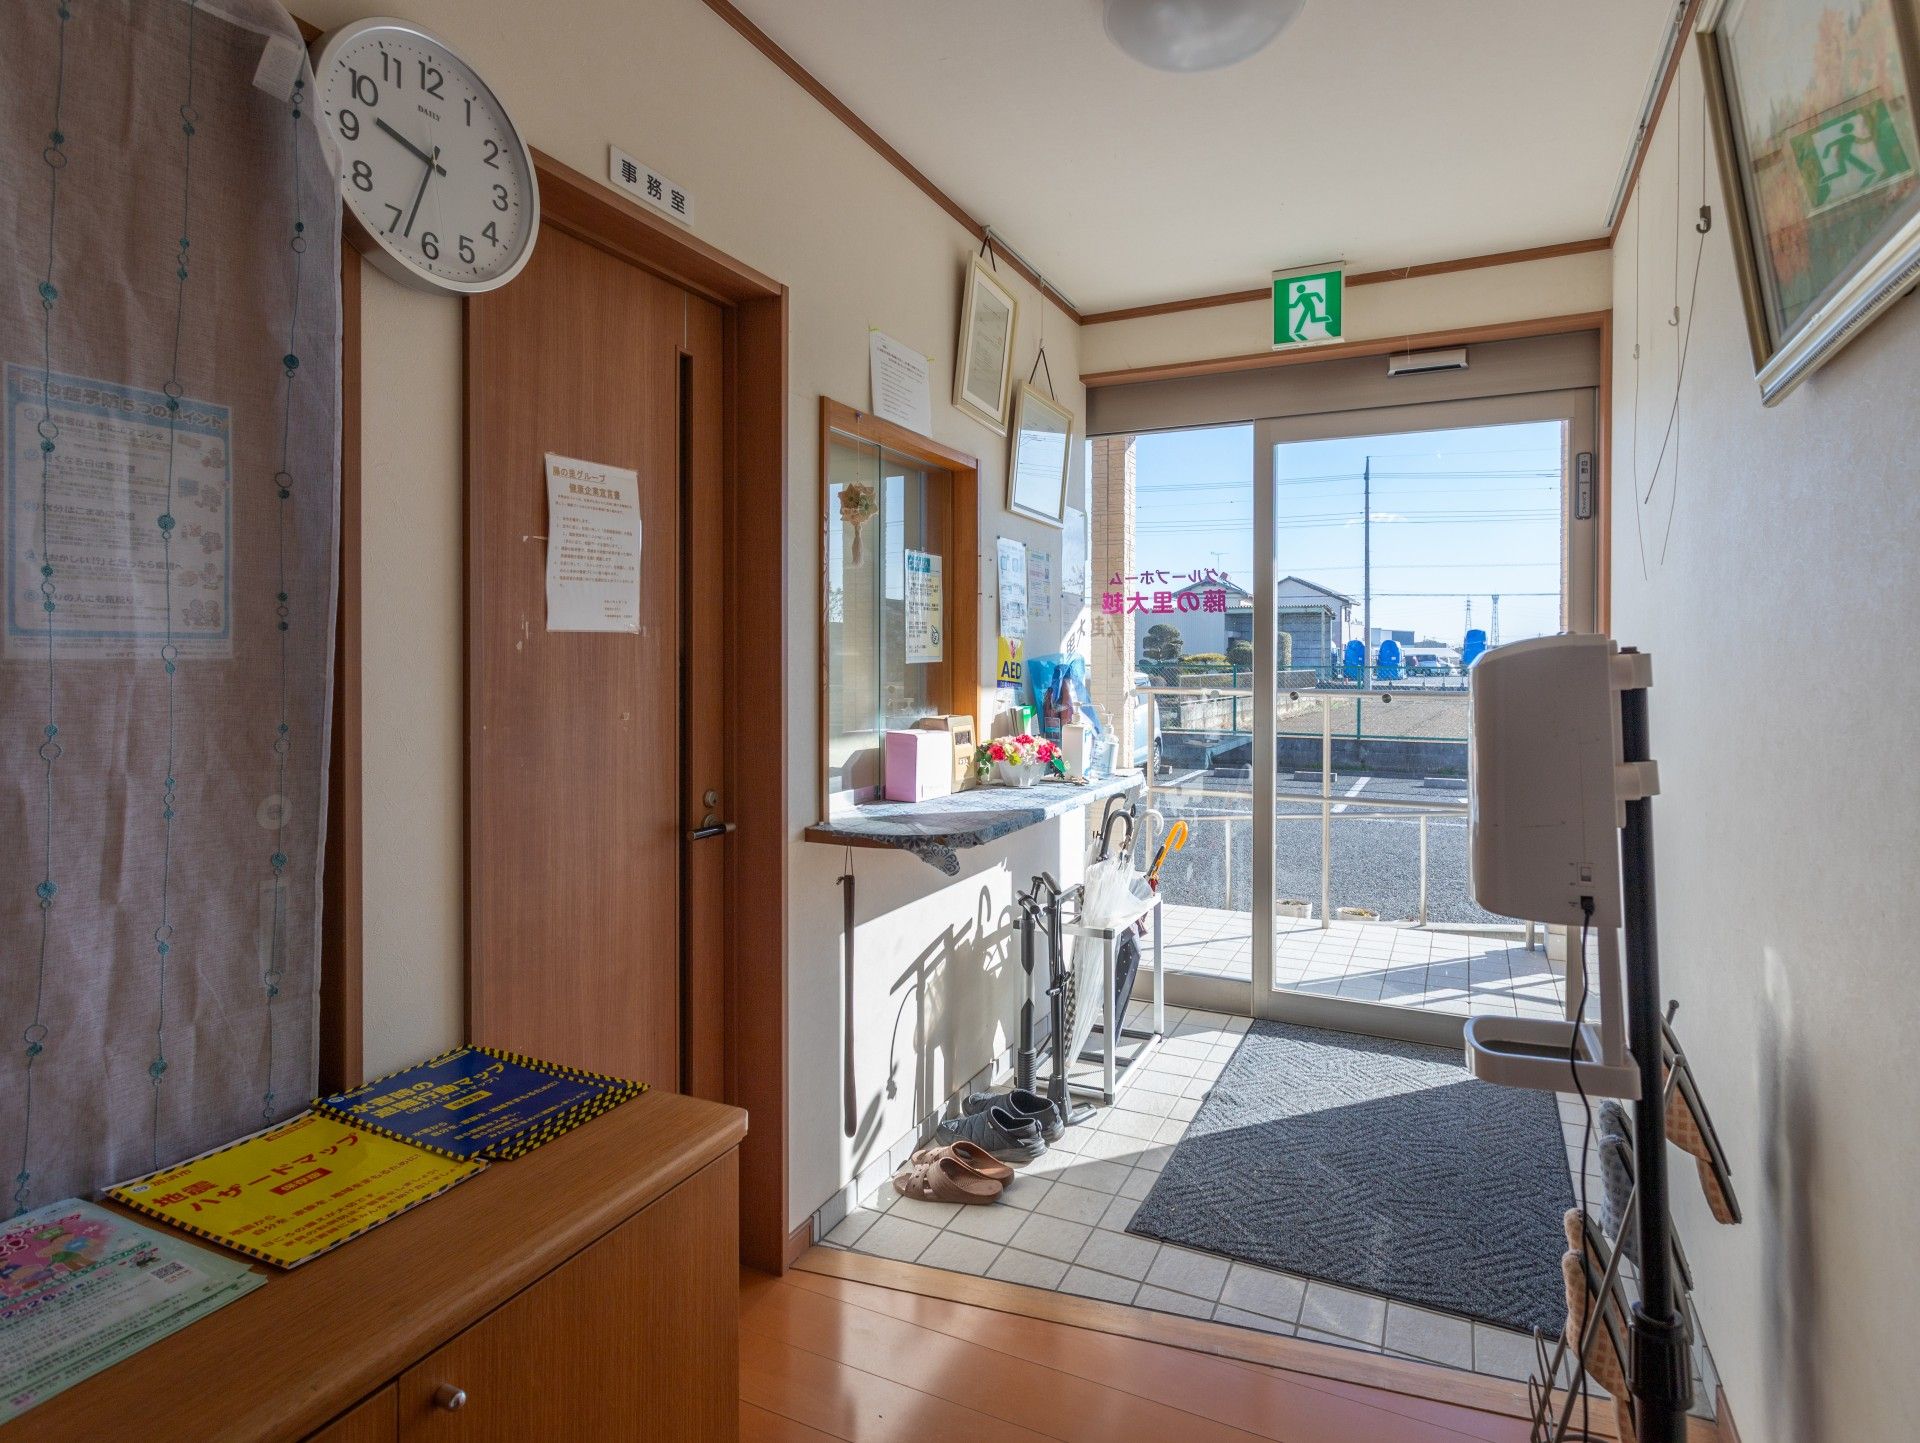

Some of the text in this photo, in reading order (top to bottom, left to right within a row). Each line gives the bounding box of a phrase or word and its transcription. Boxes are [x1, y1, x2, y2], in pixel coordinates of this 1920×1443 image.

[381, 52, 401, 89] 11
[418, 60, 444, 100] 12
[350, 67, 378, 108] 10
[339, 109, 360, 141] 9
[463, 98, 472, 126] 1
[483, 139, 499, 169] 2
[352, 160, 373, 193] 8
[621, 158, 685, 215] 事務室
[492, 184, 508, 212] 3
[385, 203, 403, 234] 7
[421, 232, 439, 260] 6
[482, 221, 499, 247] 4
[458, 236, 475, 264] 5
[1001, 661, 1021, 679] AED
[190, 1131, 361, 1211] ハザードマップ
[152, 1180, 219, 1208] 地震
